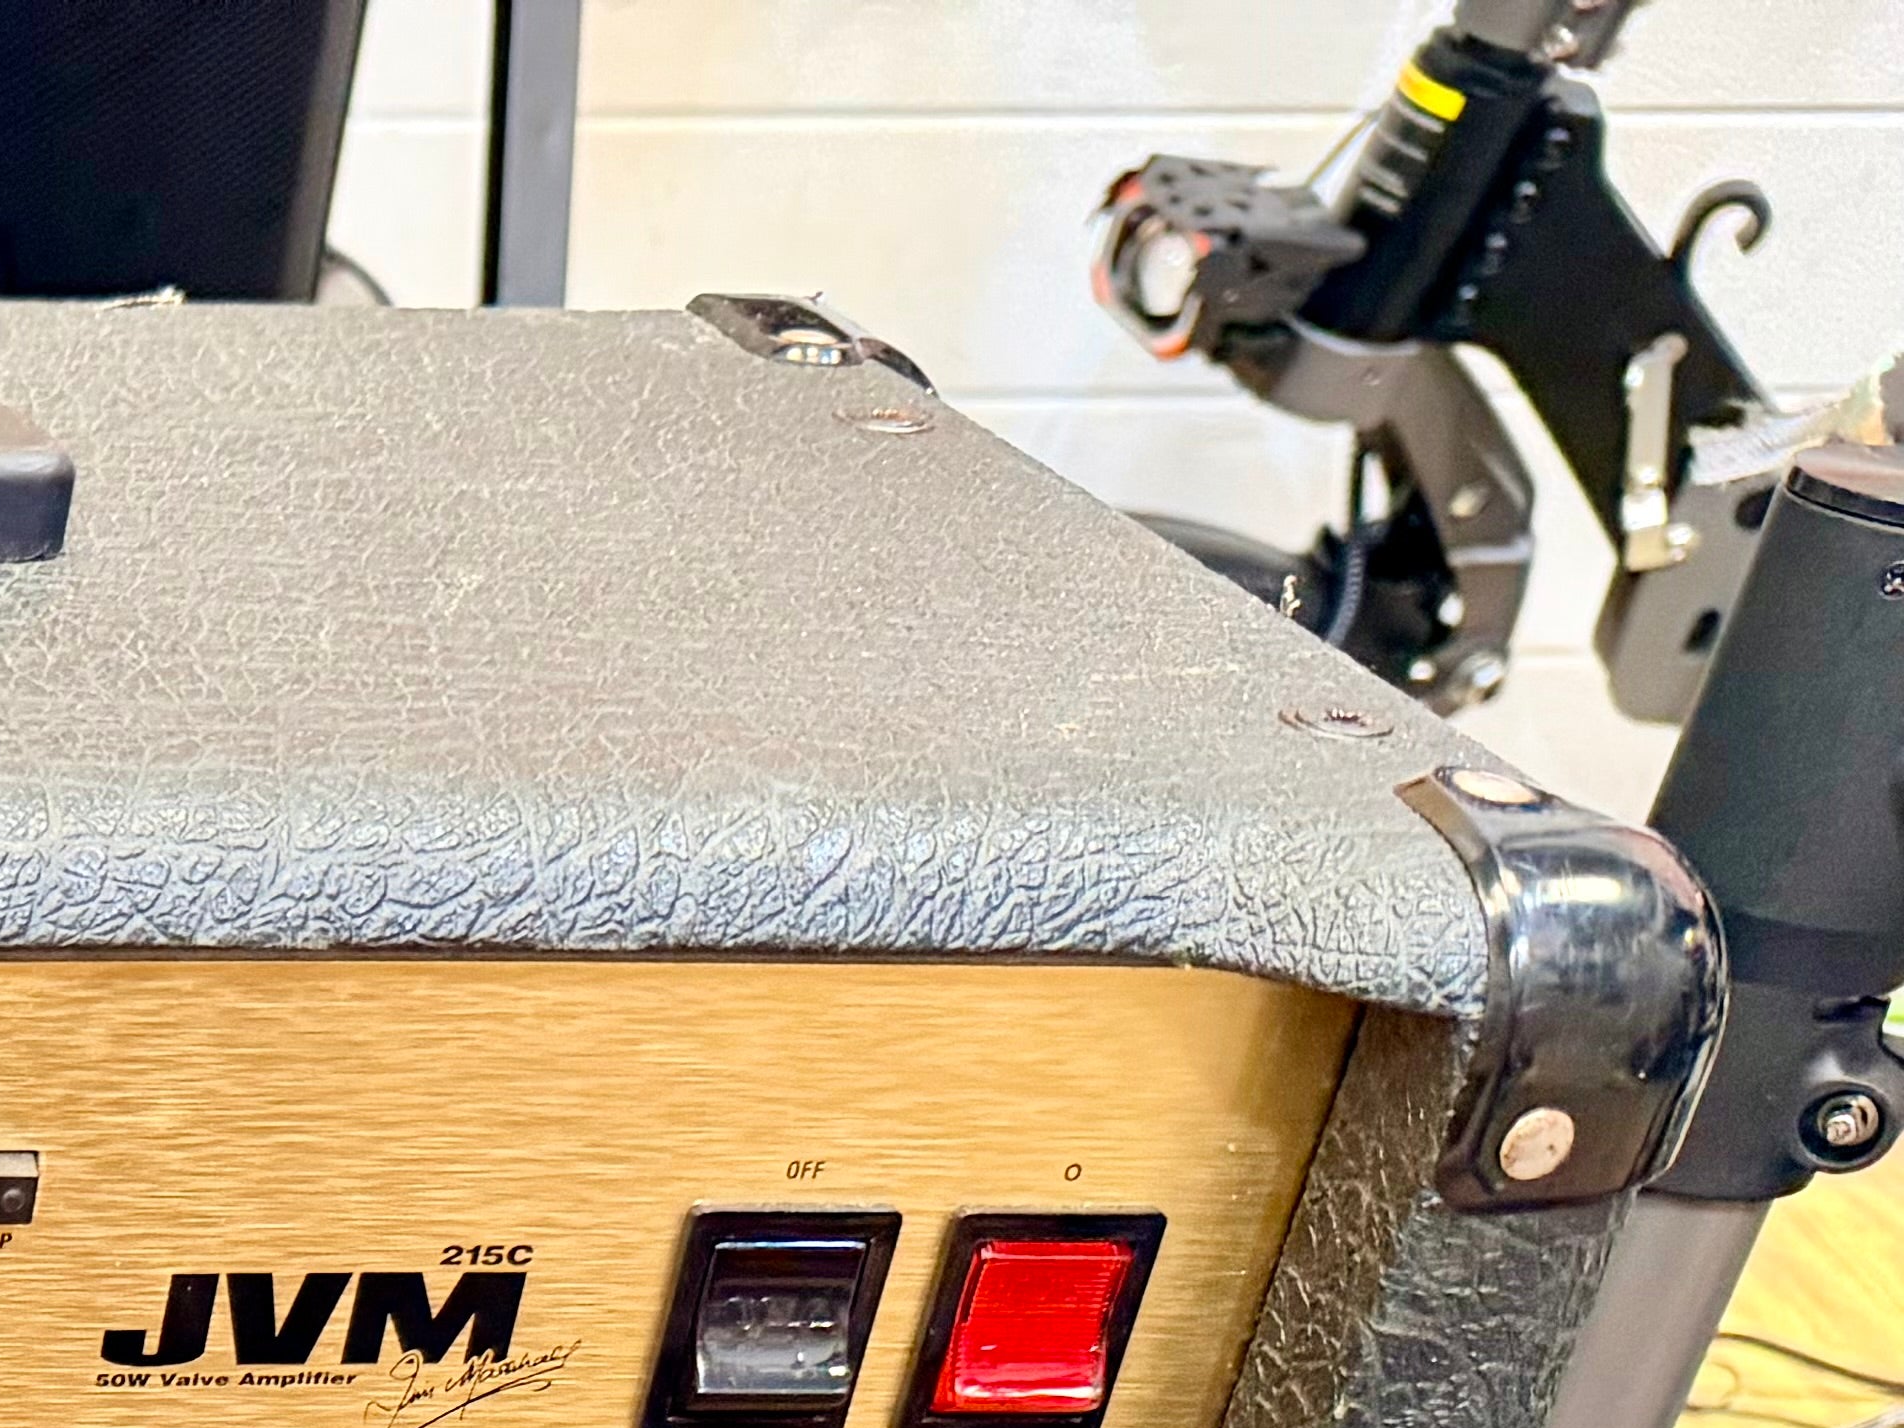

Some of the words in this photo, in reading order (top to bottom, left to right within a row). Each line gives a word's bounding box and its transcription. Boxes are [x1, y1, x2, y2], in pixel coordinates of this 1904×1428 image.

[786, 1161, 826, 1180] OFF
[440, 1245, 534, 1265] 215C
[100, 1271, 528, 1367] JVM
[95, 1373, 151, 1388] 50W
[159, 1372, 229, 1388] Valve
[237, 1372, 359, 1389] Amplifier
